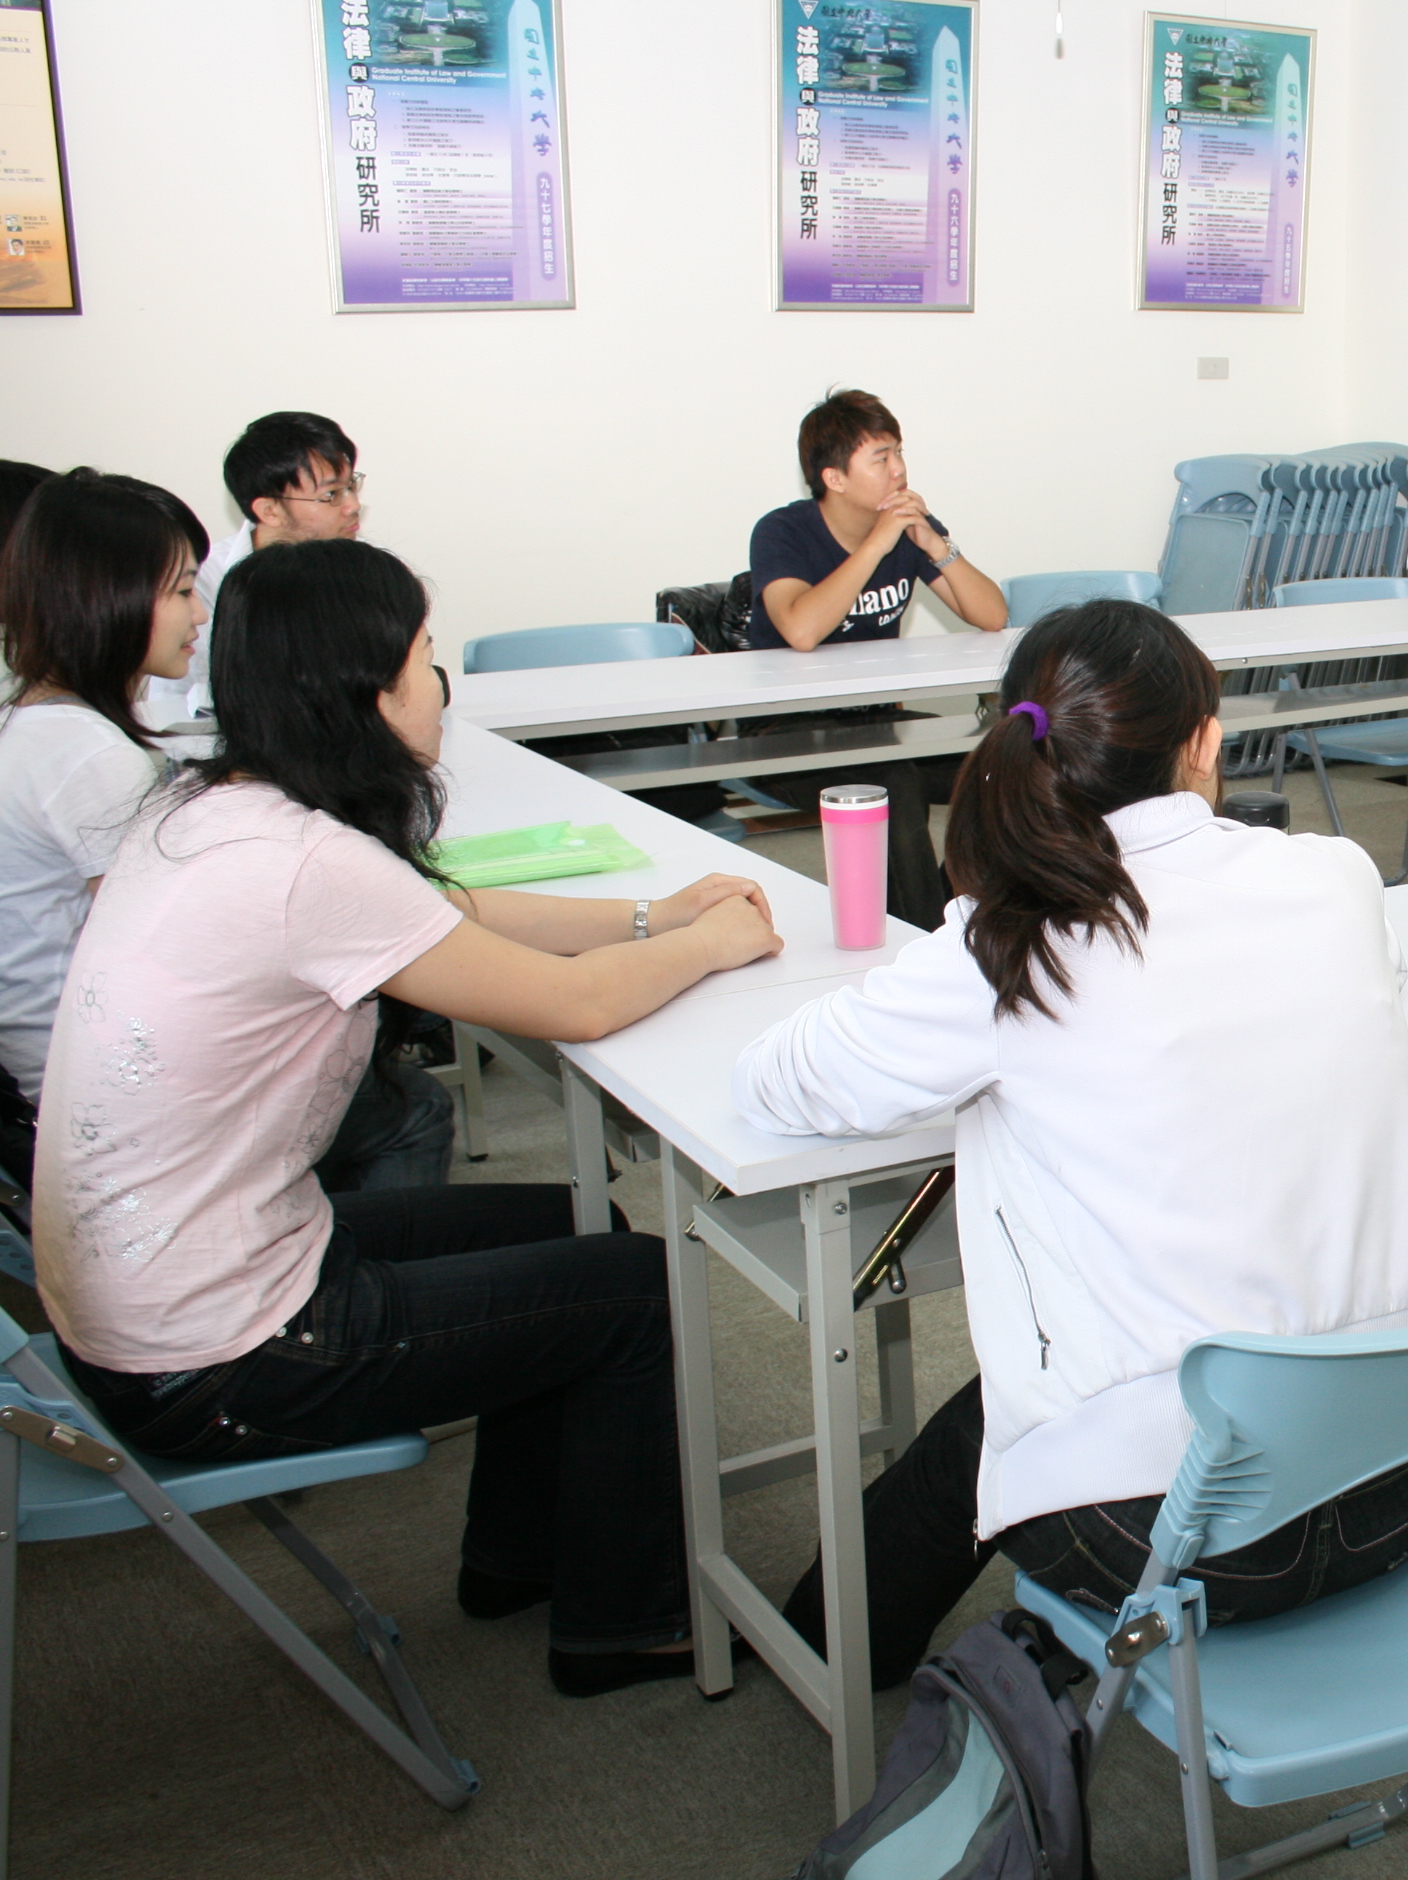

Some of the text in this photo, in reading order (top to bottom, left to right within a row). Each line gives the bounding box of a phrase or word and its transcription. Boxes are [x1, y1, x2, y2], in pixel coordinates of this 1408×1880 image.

[371, 66, 403, 75] Graduate
[404, 67, 430, 76] Institute
[431, 68, 438, 76] of
[439, 69, 451, 77] Law
[467, 70, 507, 79] Government
[372, 74, 457, 85] National Central University
[795, 26, 820, 240] 法律與政府研究所
[1160, 52, 1184, 246] 法律與政府研究所
[540, 177, 555, 275] 九十七學年度招生
[949, 193, 960, 281] 九十六學年度招生
